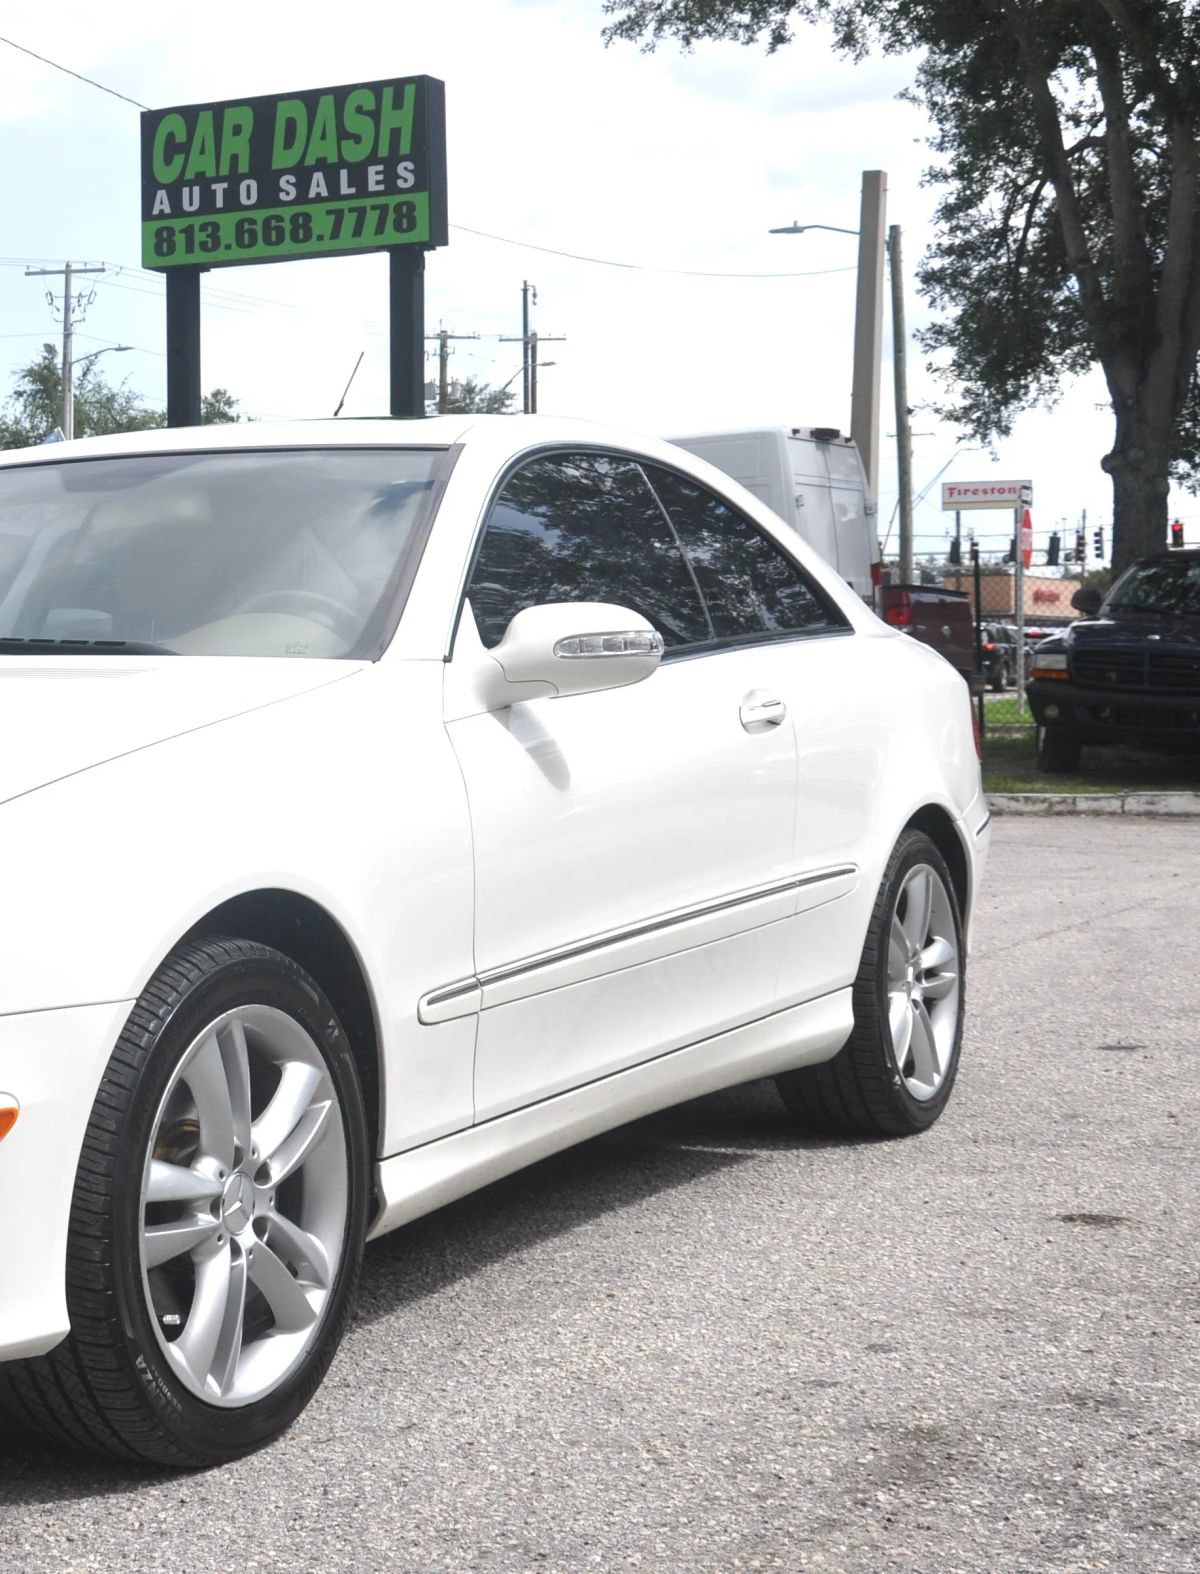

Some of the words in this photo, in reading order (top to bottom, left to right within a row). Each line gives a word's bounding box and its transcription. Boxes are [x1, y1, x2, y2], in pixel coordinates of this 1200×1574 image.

[152, 105, 254, 185] CAR
[271, 83, 417, 171] DASH
[152, 179, 258, 215] AUTO
[279, 161, 415, 201] SALES
[154, 200, 417, 258] 813.668.7778
[947, 486, 1019, 498] Fireston
